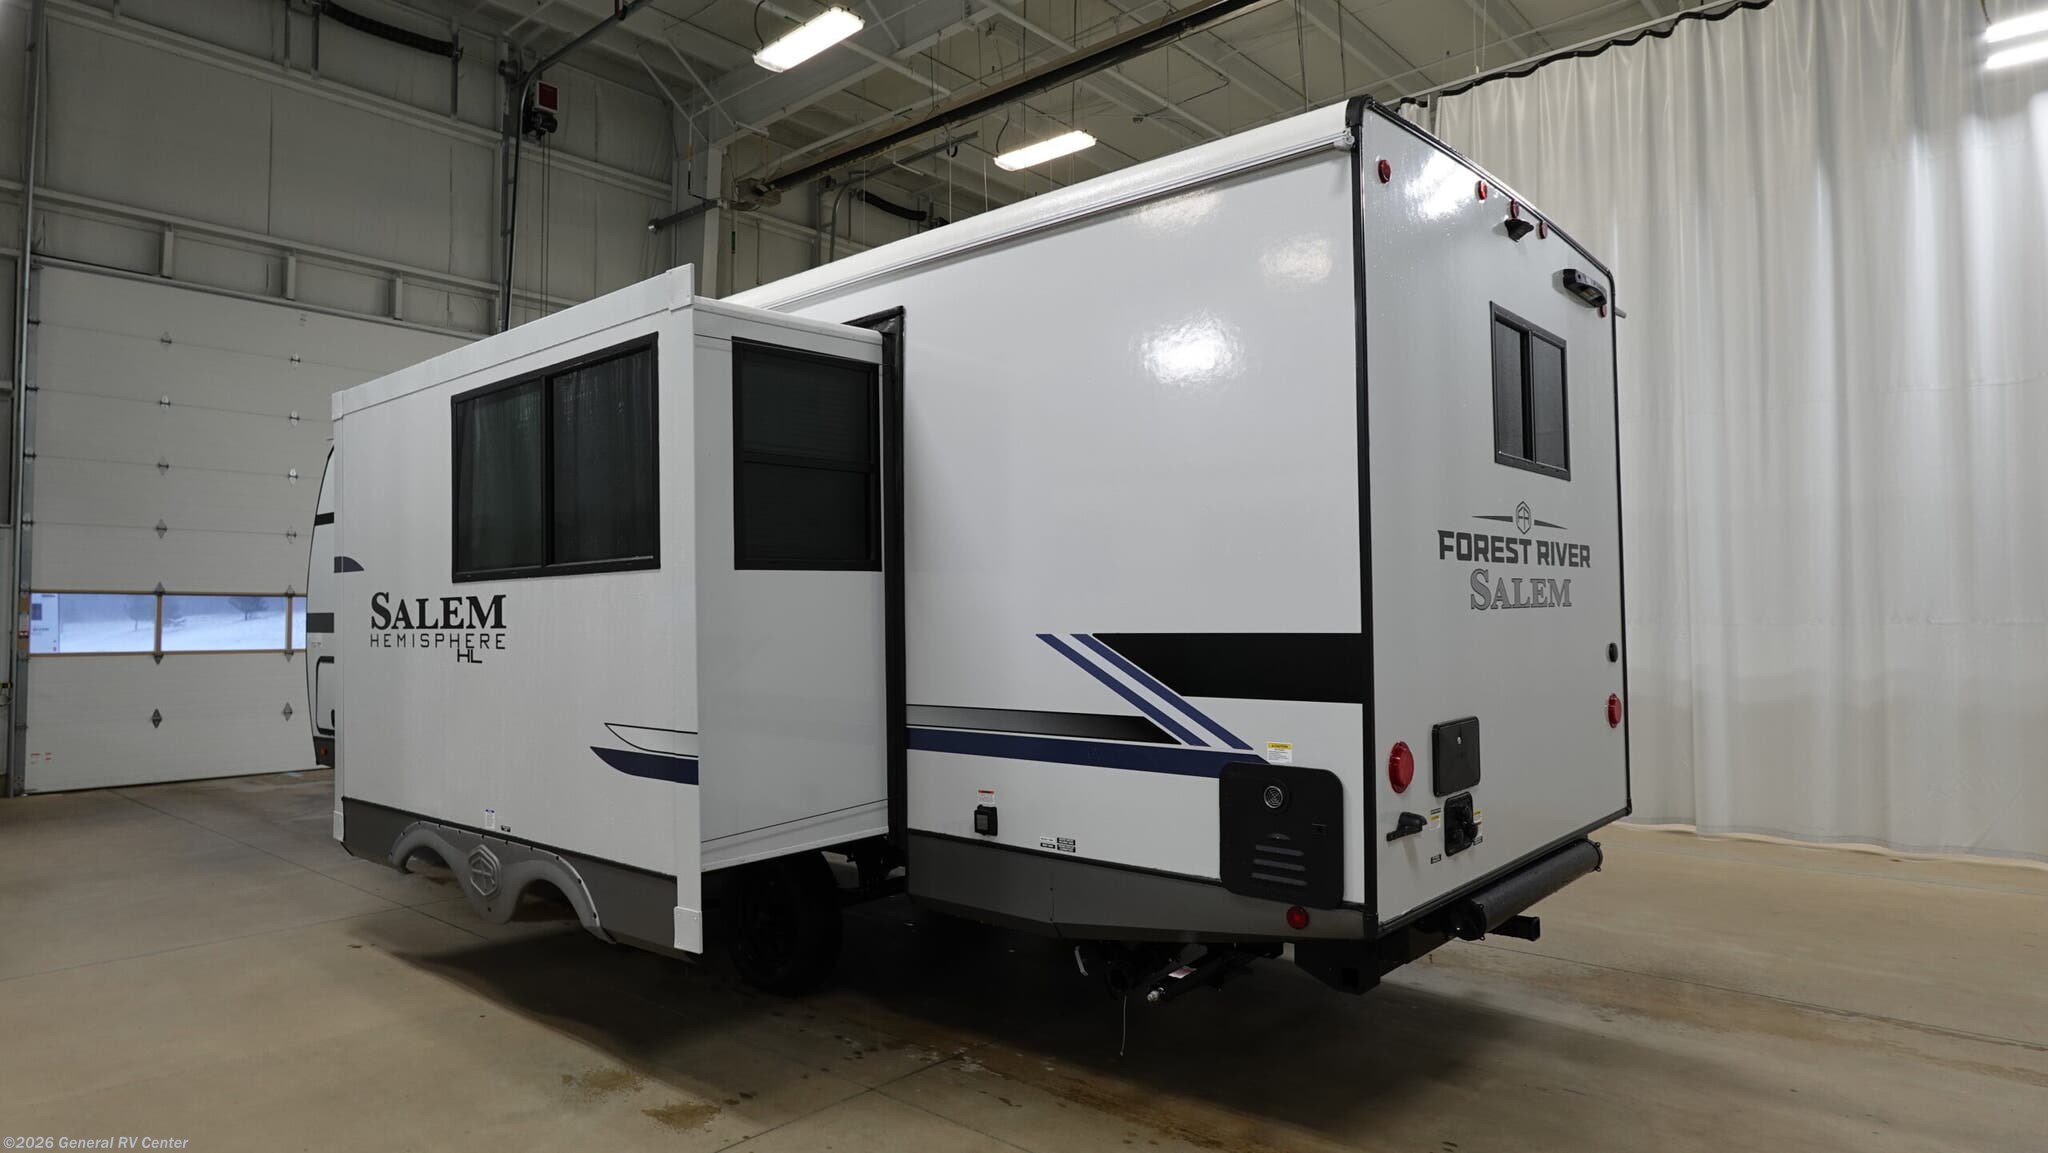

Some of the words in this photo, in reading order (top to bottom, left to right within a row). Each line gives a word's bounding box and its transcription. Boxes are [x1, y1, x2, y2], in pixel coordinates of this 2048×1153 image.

[1437, 530, 1532, 565] FOREST
[1535, 540, 1591, 568] RIVER
[1470, 568, 1573, 611] SALEM
[371, 592, 507, 630] SALEM
[370, 632, 506, 650] HEMISPHERE
[457, 648, 483, 664] HL
